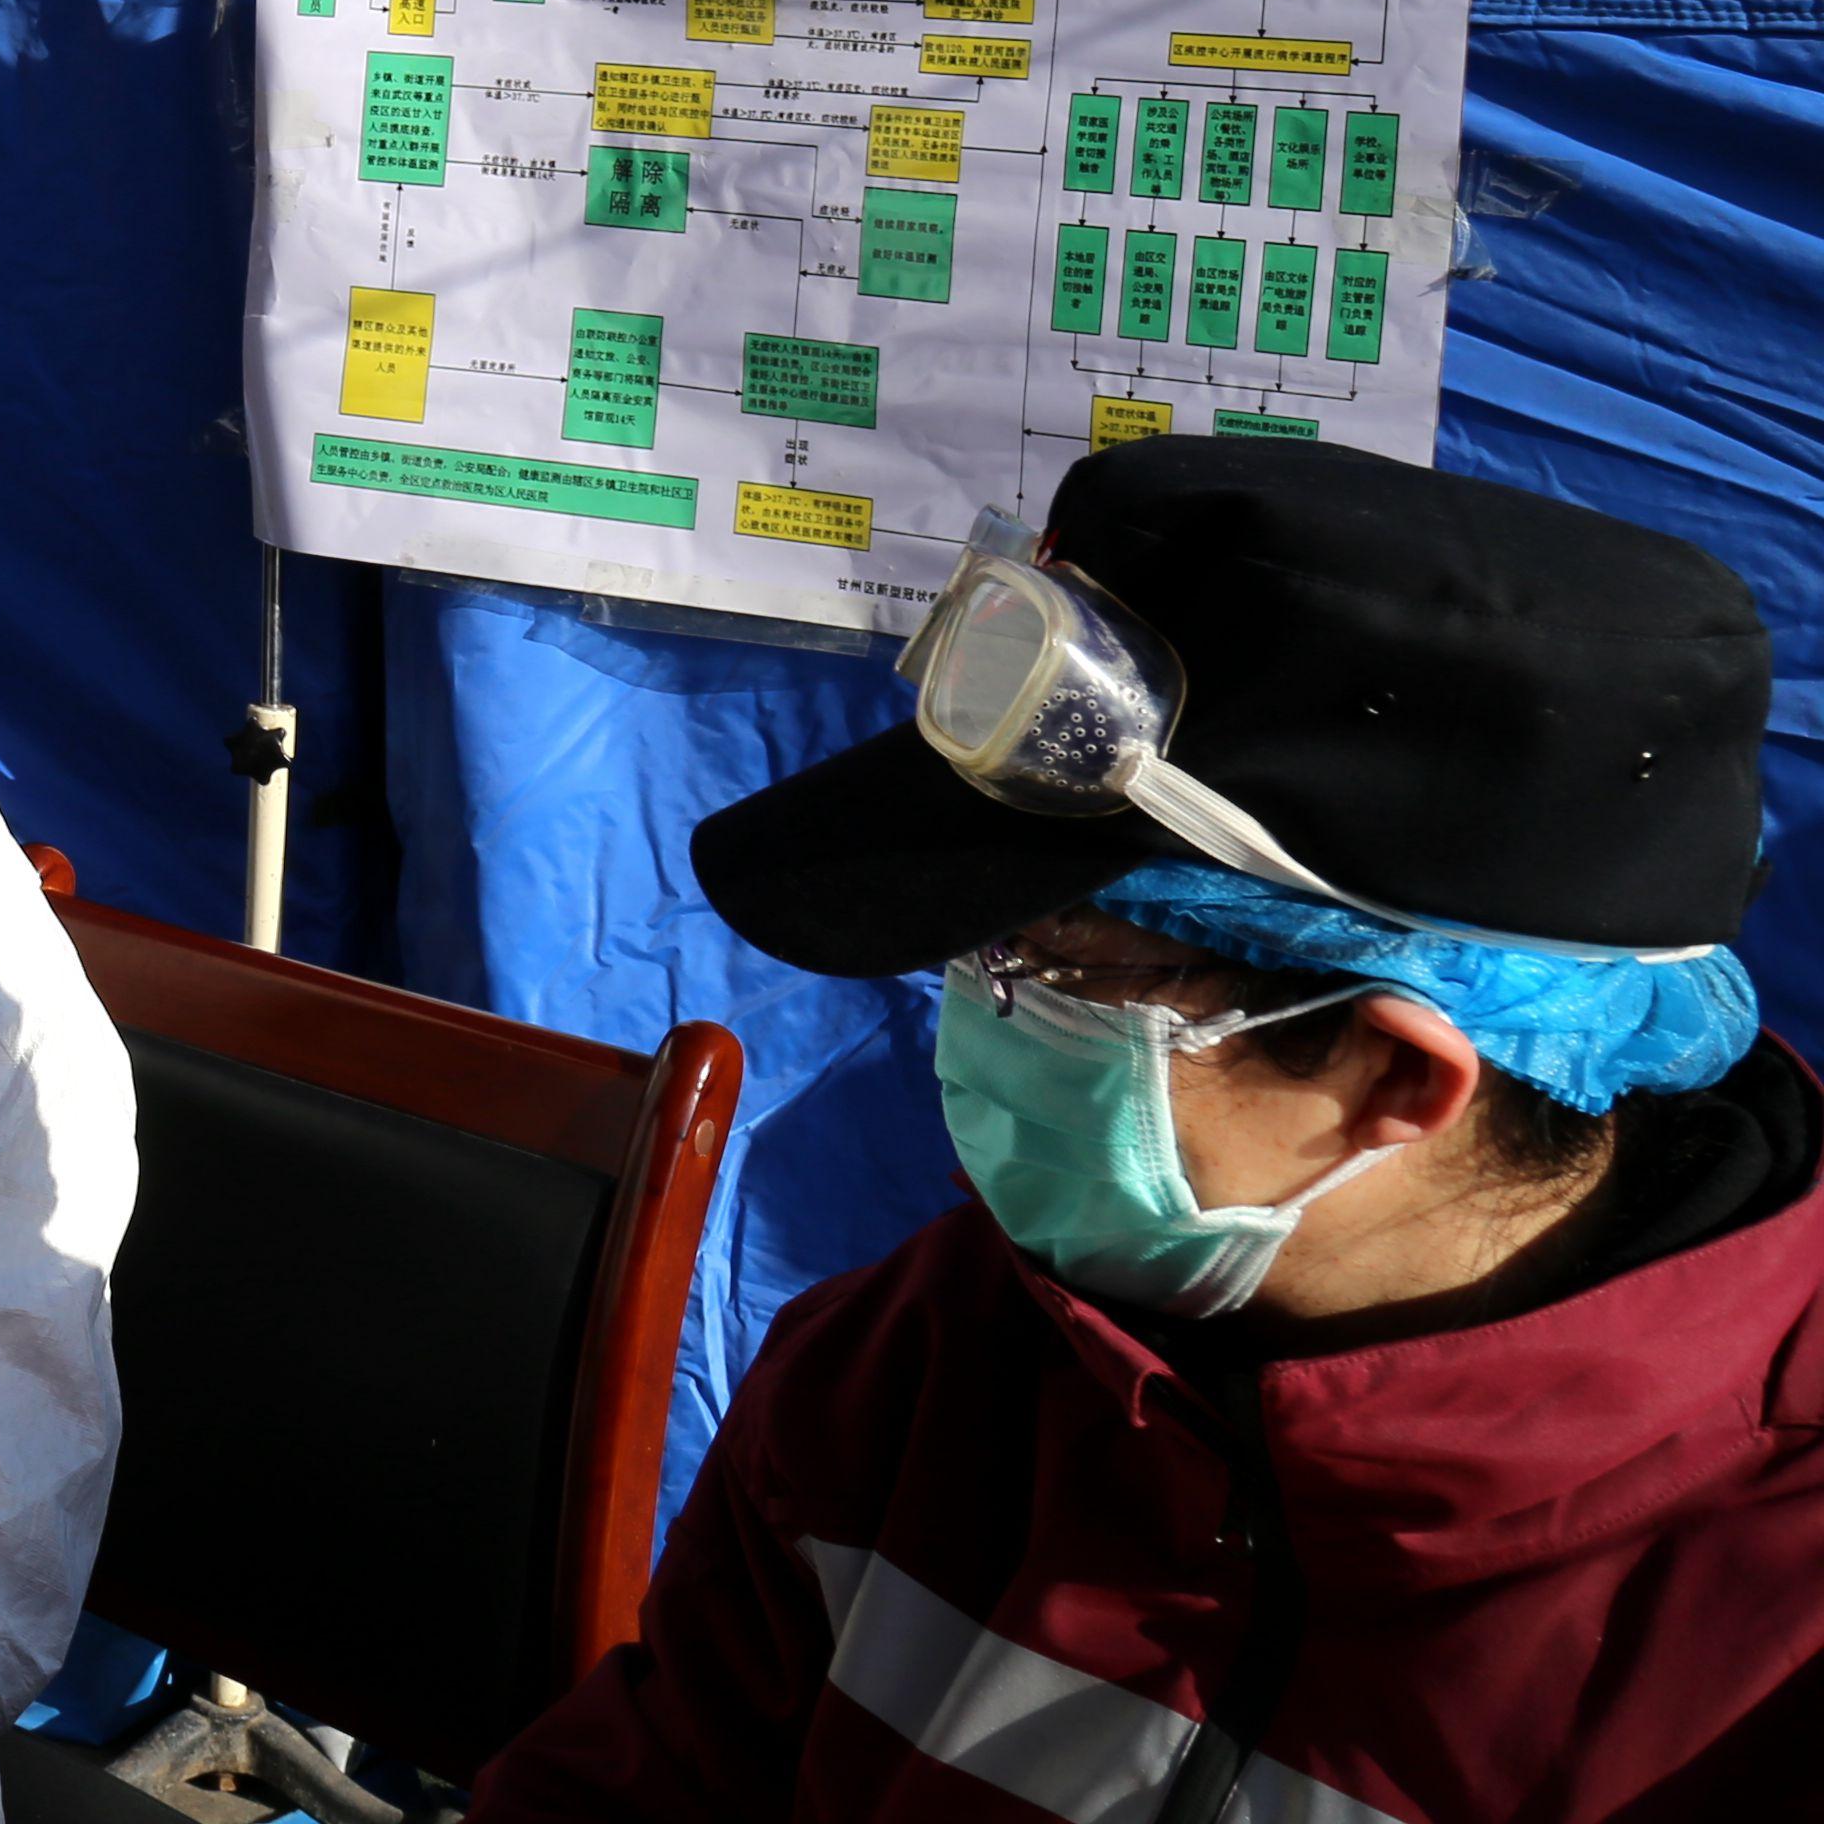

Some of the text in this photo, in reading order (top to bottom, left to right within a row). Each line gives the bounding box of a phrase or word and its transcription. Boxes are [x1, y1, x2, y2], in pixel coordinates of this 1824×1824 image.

[398, 12, 425, 26] 入口
[370, 89, 444, 104] 来自武汉等重点
[369, 106, 444, 119] 疫区的返甘入甘
[1210, 109, 1254, 122] 公共场所
[367, 139, 440, 154] 对重点人群开展
[610, 157, 664, 184] 解除
[609, 189, 661, 218] 隔离
[352, 319, 429, 337] 辖区群众及其他
[375, 361, 396, 374] 人员
